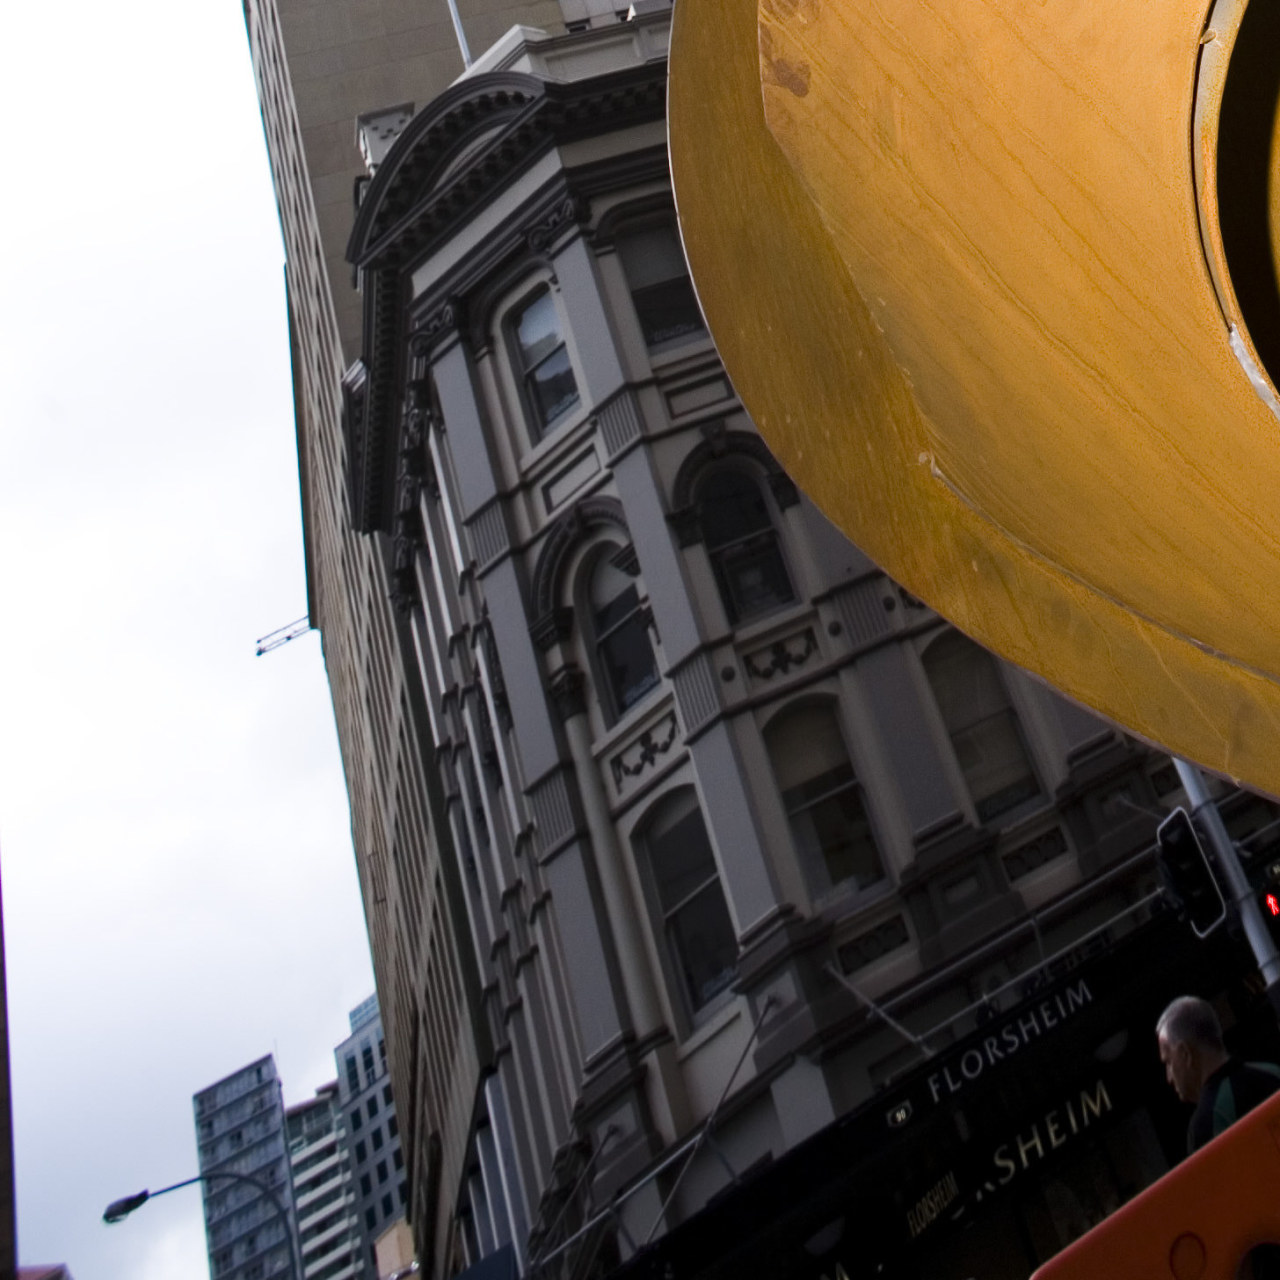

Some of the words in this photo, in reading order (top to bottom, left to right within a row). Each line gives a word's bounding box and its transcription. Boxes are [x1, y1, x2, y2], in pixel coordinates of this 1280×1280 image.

[926, 977, 1095, 1104] FLORSHEIM
[978, 1078, 1113, 1200] SHEIM
[907, 1169, 960, 1238] FLORSHEIM
